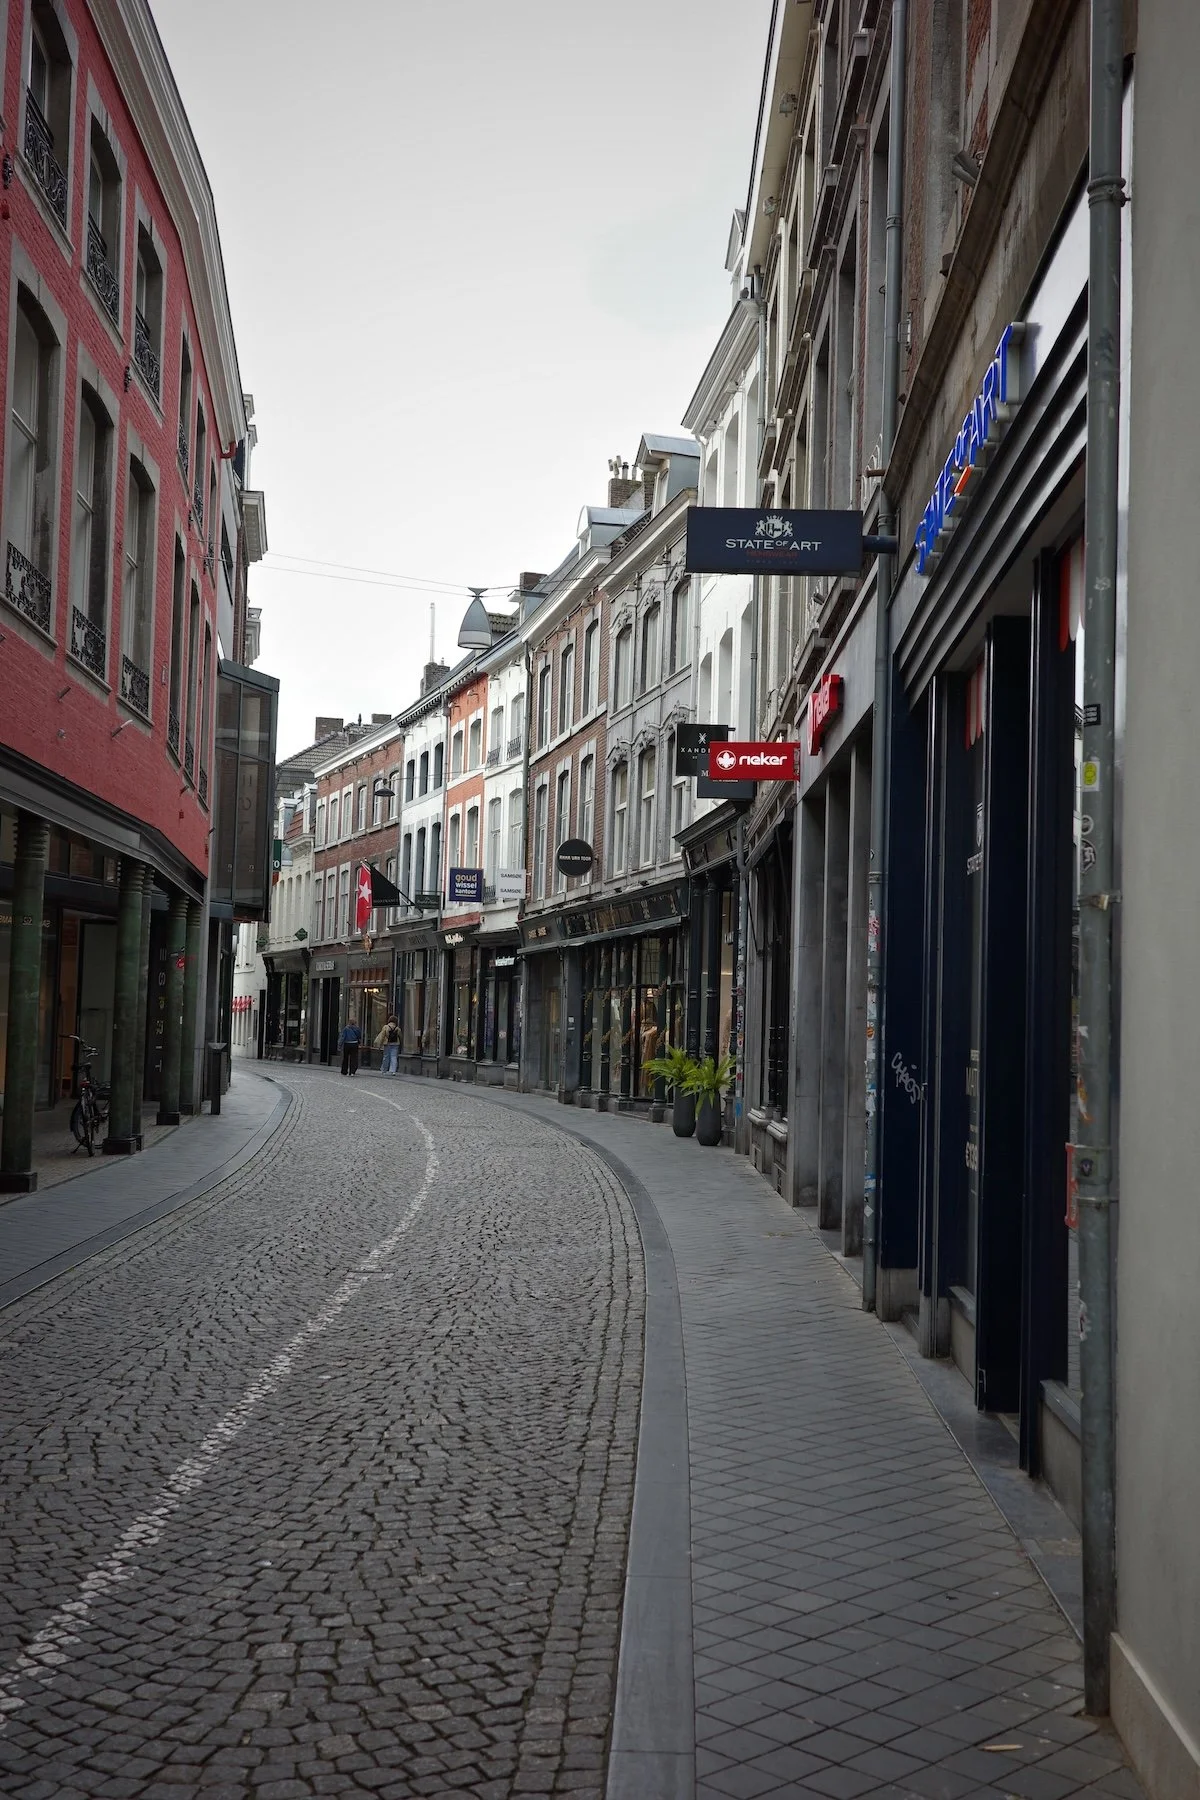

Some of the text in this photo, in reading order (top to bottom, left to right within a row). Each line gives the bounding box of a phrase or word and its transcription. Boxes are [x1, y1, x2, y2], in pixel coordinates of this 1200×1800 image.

[725, 538, 775, 550] STATE
[789, 541, 822, 551] ART
[738, 752, 788, 766] rieker
[455, 873, 477, 883] goud
[455, 881, 477, 889] wissel
